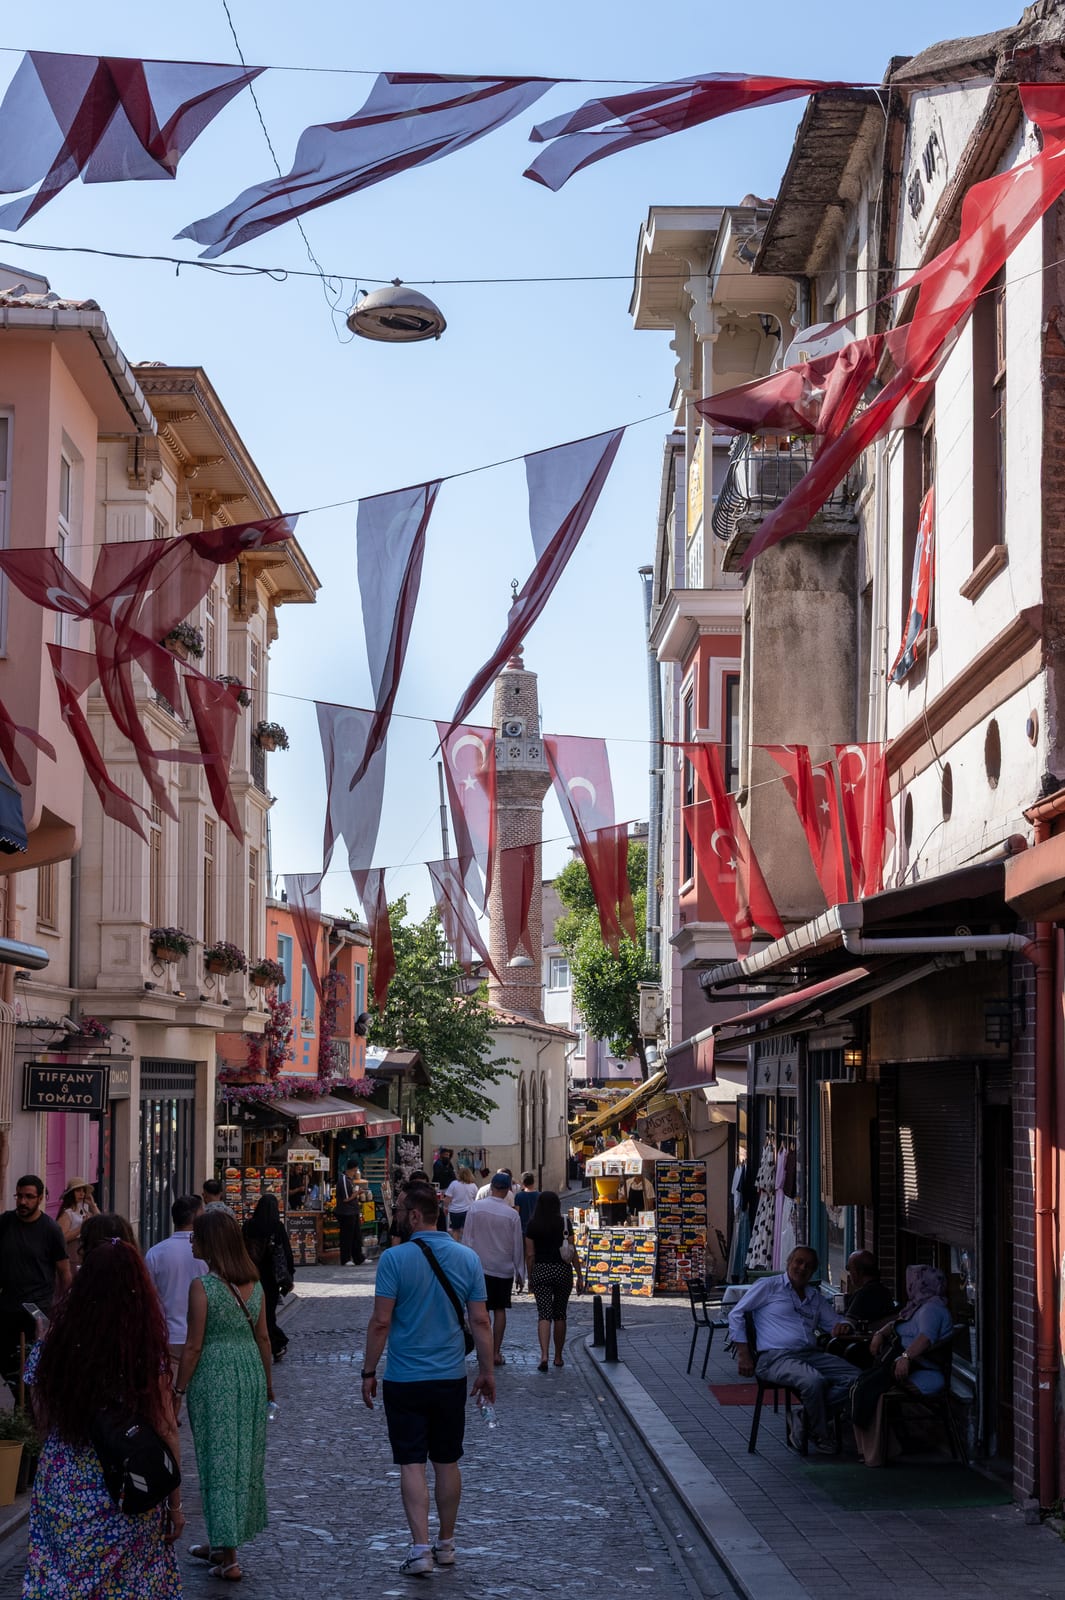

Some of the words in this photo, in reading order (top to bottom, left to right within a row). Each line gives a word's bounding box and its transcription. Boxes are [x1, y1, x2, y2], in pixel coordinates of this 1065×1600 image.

[38, 1072, 94, 1084] TIFFANY
[61, 1083, 69, 1093] &
[37, 1092, 93, 1104] TOMATO
